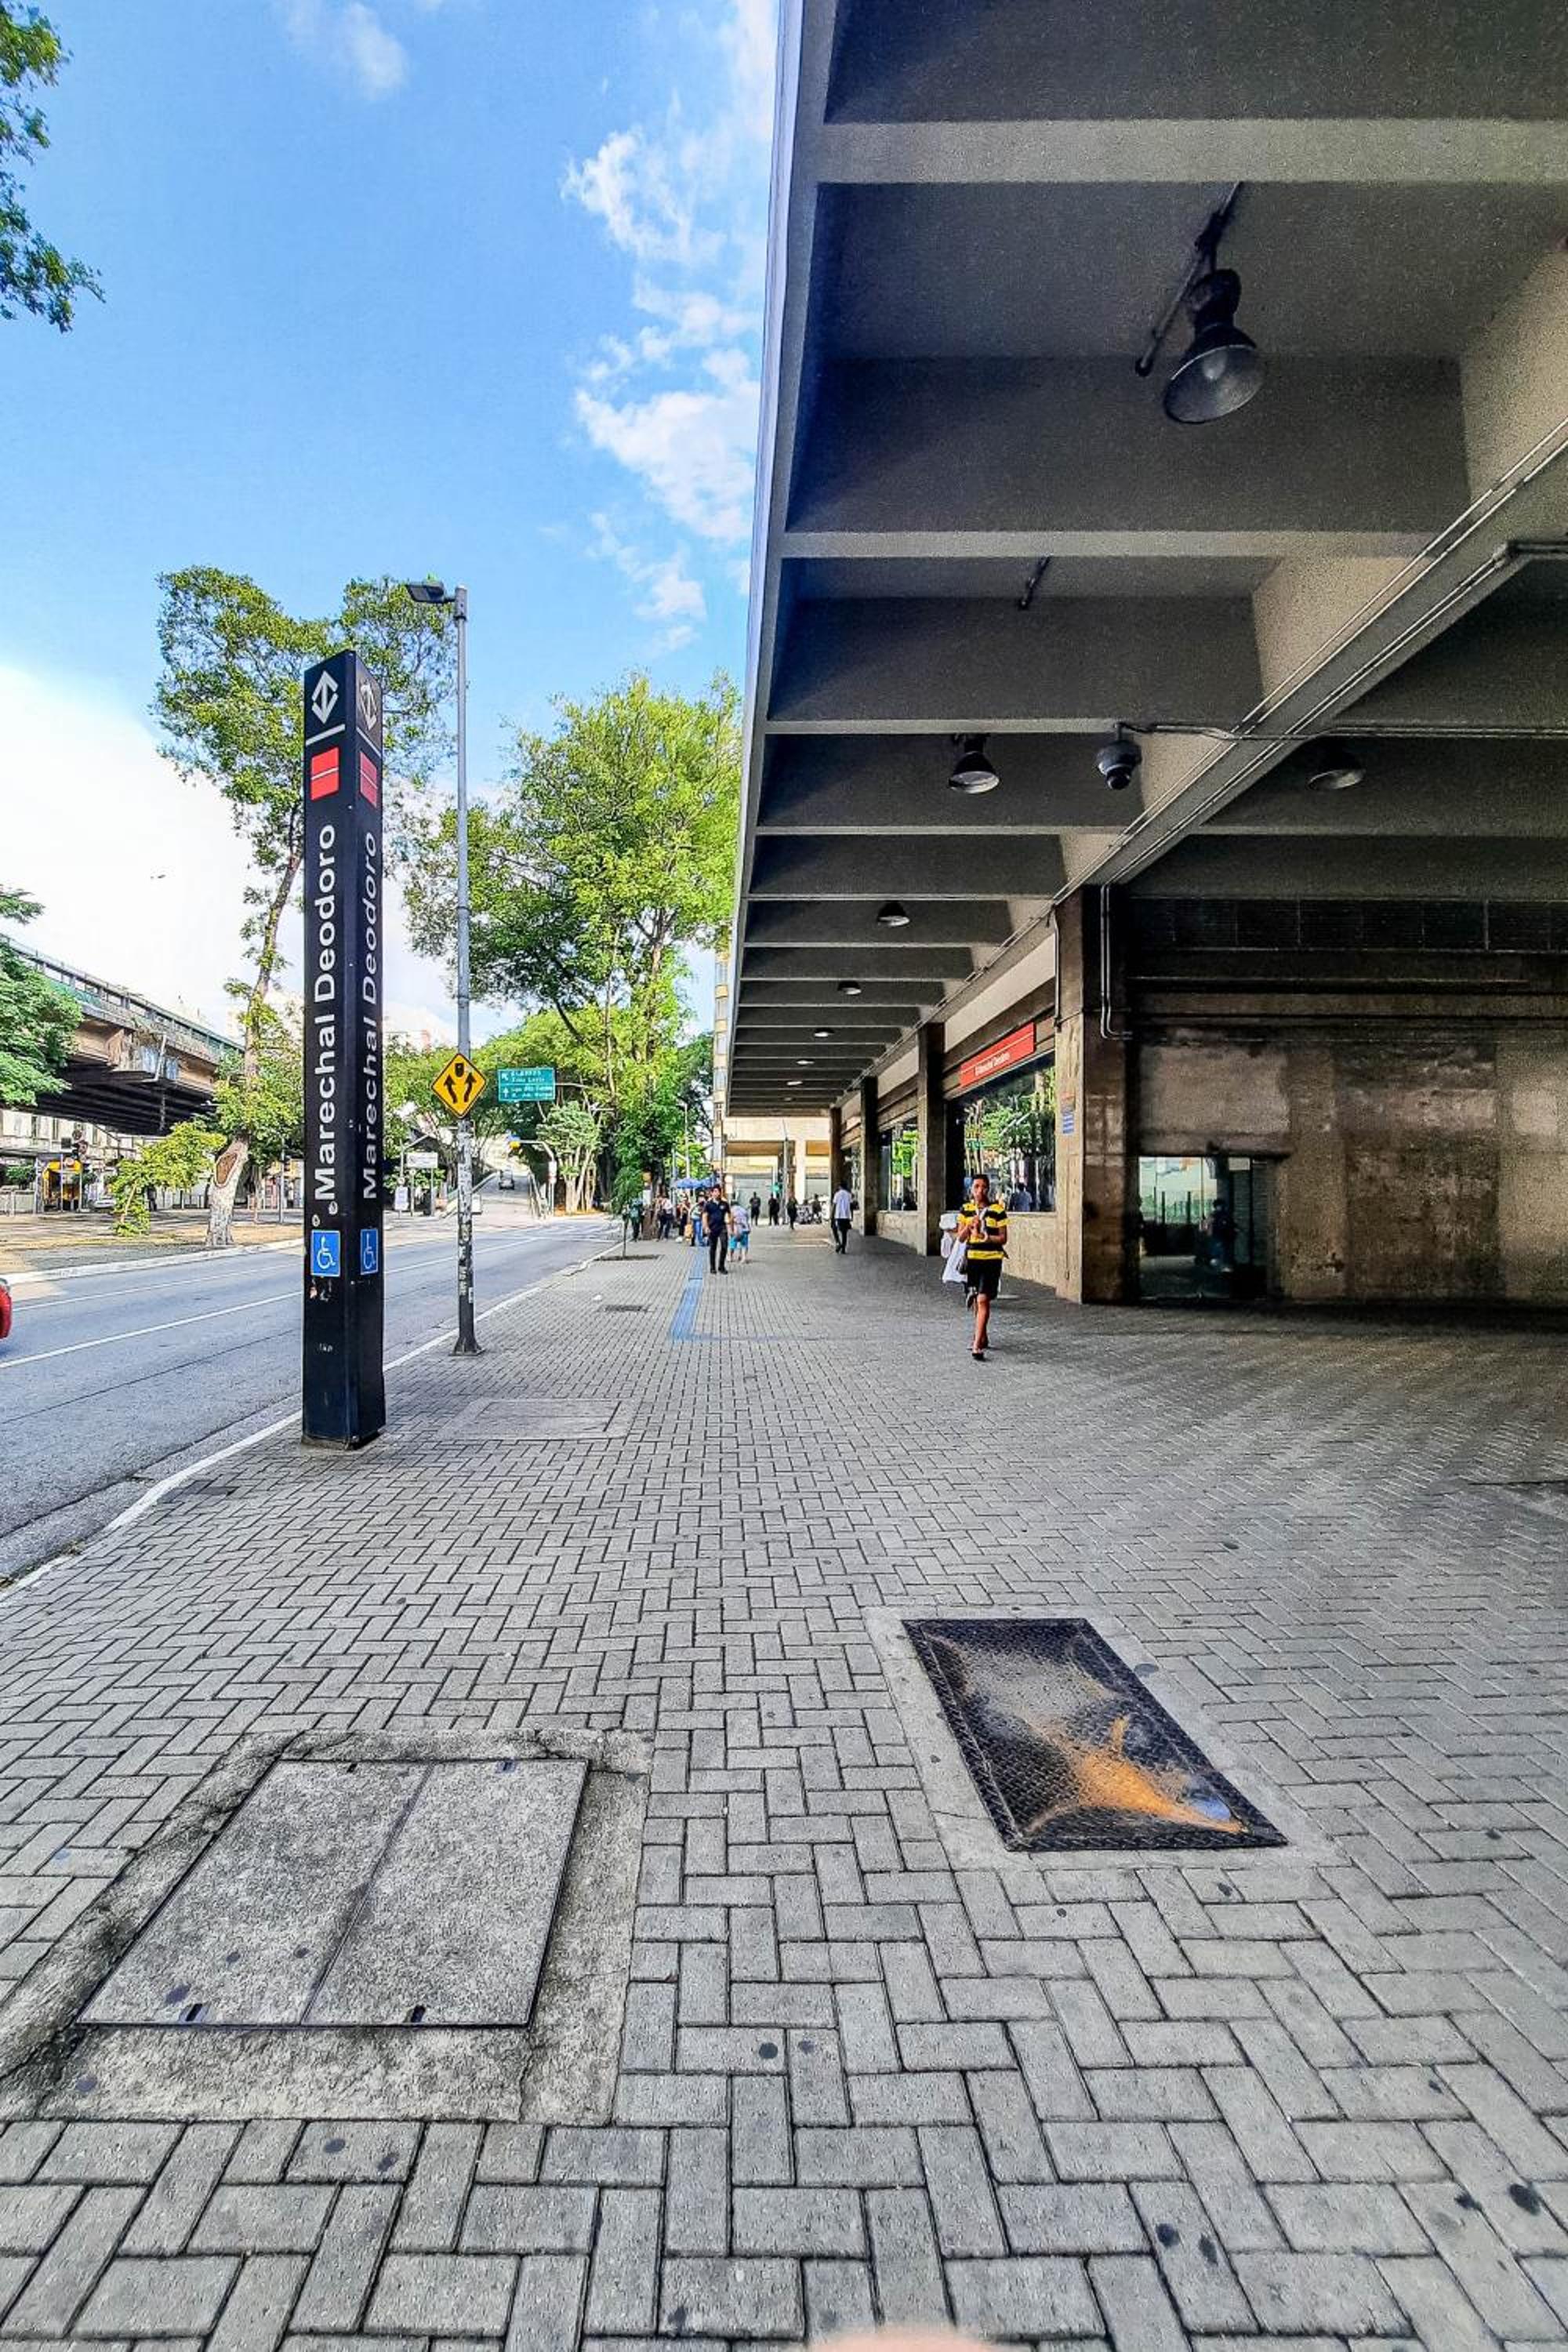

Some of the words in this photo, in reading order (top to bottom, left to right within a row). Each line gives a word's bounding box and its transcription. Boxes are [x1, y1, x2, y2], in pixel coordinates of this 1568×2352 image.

[314, 825, 336, 1003] Deodoro
[363, 832, 377, 1004] Deodoro
[314, 1014, 336, 1200] Marechal
[363, 1016, 377, 1199] Marechal
